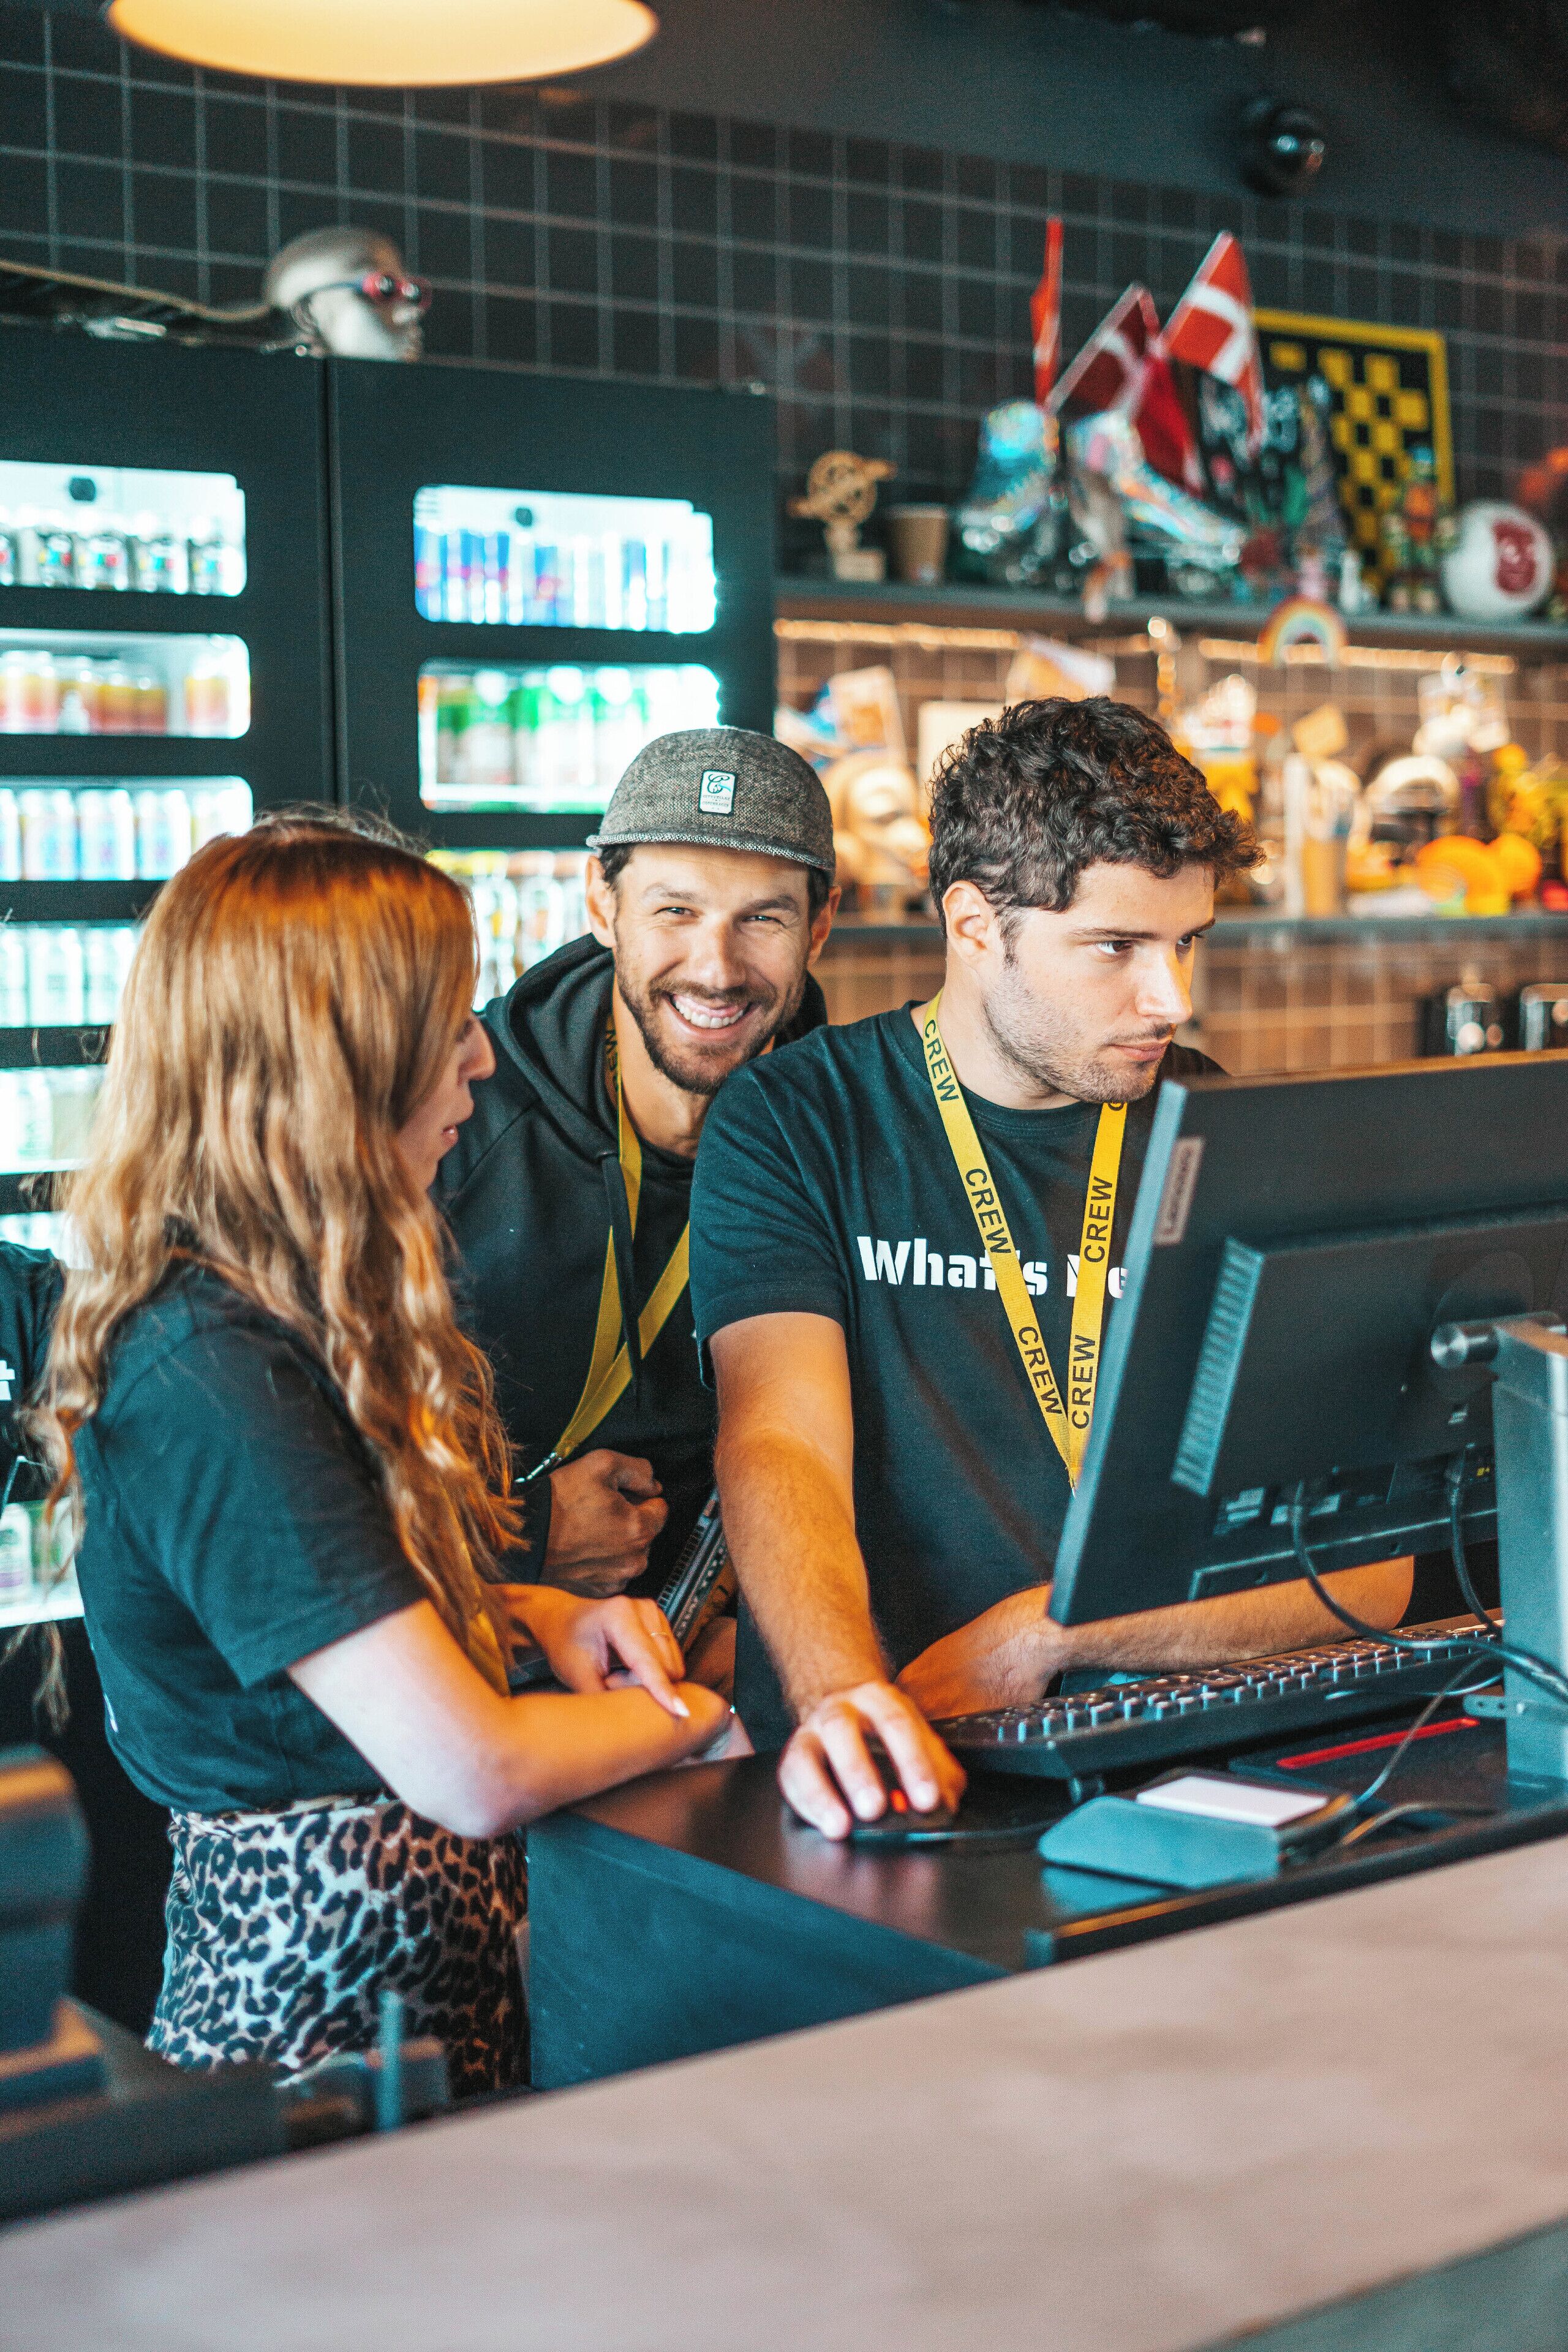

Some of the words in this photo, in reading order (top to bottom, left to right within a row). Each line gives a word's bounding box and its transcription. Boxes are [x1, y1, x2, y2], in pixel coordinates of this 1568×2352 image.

[924, 1019, 959, 1102] CREW
[965, 1167, 1012, 1254] CREW
[1084, 1175, 1113, 1263] CREW
[1018, 1326, 1063, 1414] CREW
[1072, 1334, 1096, 1430] CREW
